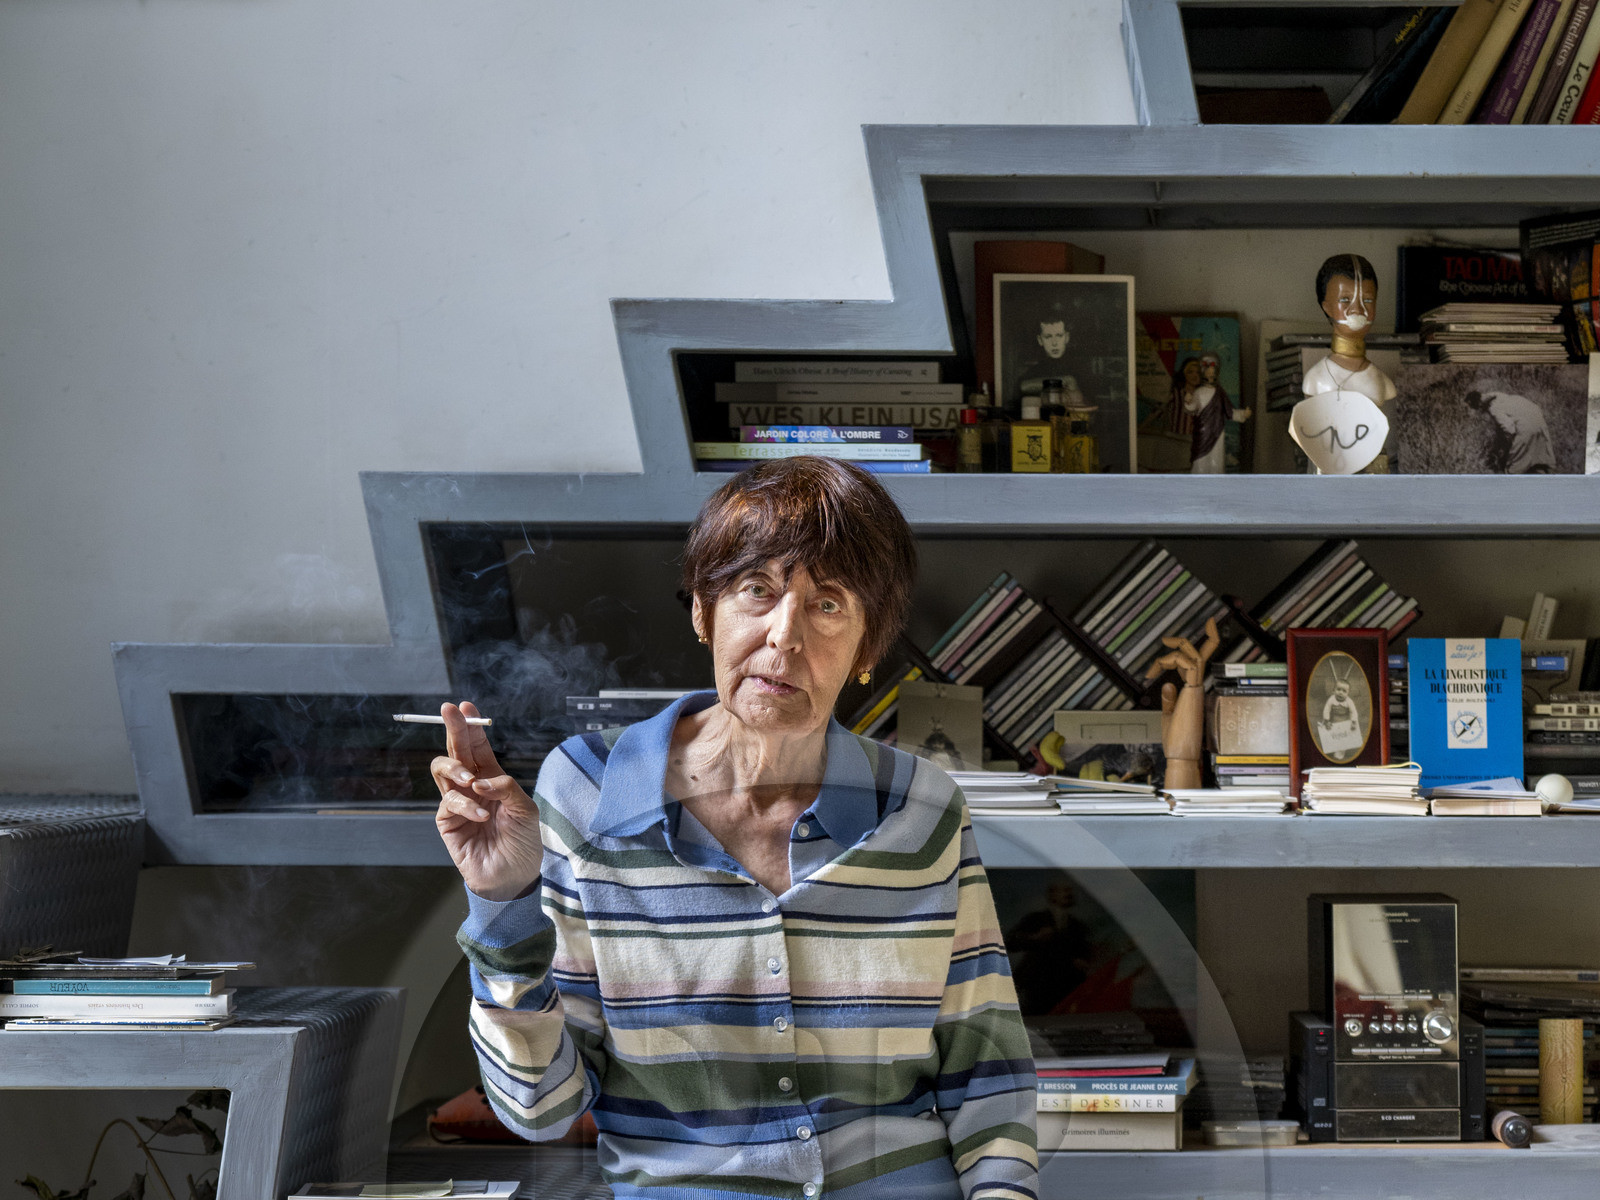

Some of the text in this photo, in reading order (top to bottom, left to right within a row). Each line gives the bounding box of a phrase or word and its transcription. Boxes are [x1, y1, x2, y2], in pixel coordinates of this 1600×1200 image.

[1573, 62, 1590, 82] Le
[1442, 256, 1483, 280] TAO
[737, 407, 960, 427] YVES KLEIN USA
[754, 428, 881, 439] JARDIN COLORÉ À L'OMBRE
[732, 445, 800, 457] Terrasses
[1425, 669, 1508, 681] LA LINGUISTIQUE
[1430, 683, 1503, 695] DIACHRONIQUE
[49, 983, 89, 992] VOYEUR
[1092, 1082, 1119, 1090] PROCÈS
[1041, 1099, 1165, 1108] EST DESSINER
